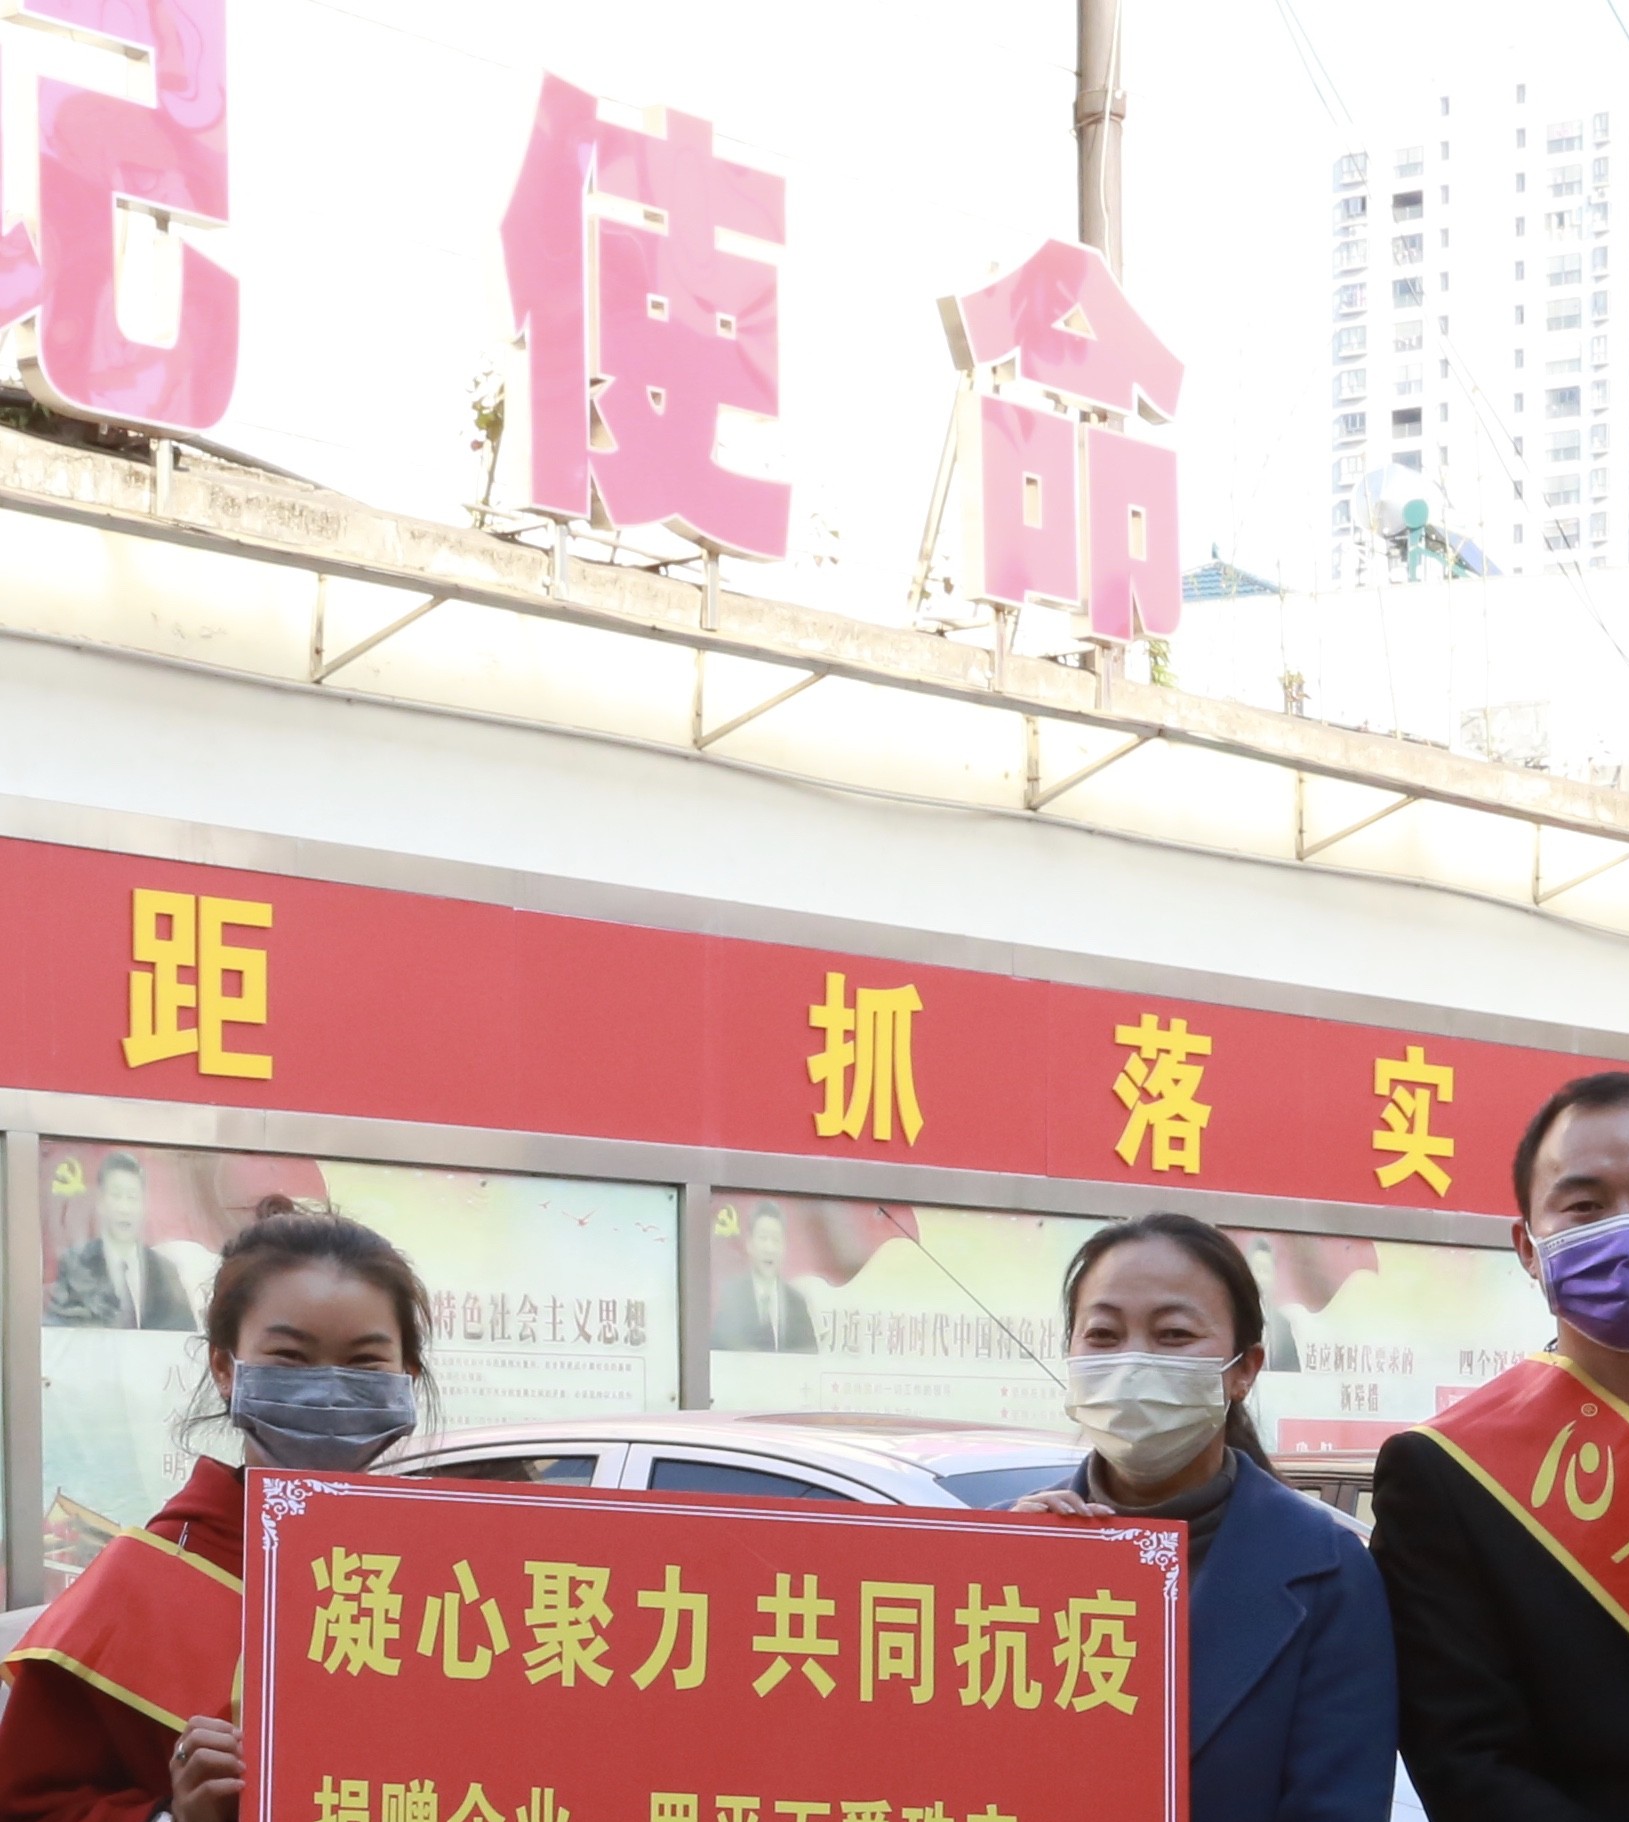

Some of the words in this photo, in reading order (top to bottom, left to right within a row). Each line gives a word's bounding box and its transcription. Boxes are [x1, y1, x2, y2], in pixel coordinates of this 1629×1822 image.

[122, 887, 274, 1080] 距
[433, 1289, 647, 1347] 特色社会主义思想
[819, 1308, 1069, 1362] 习近平新时代中国特色社
[1304, 1342, 1415, 1376] 适应新时代要求的
[1340, 1381, 1380, 1413] 新举措
[307, 1546, 709, 1690] 凝心聚力
[752, 1572, 1138, 1715] 共同抗疫
